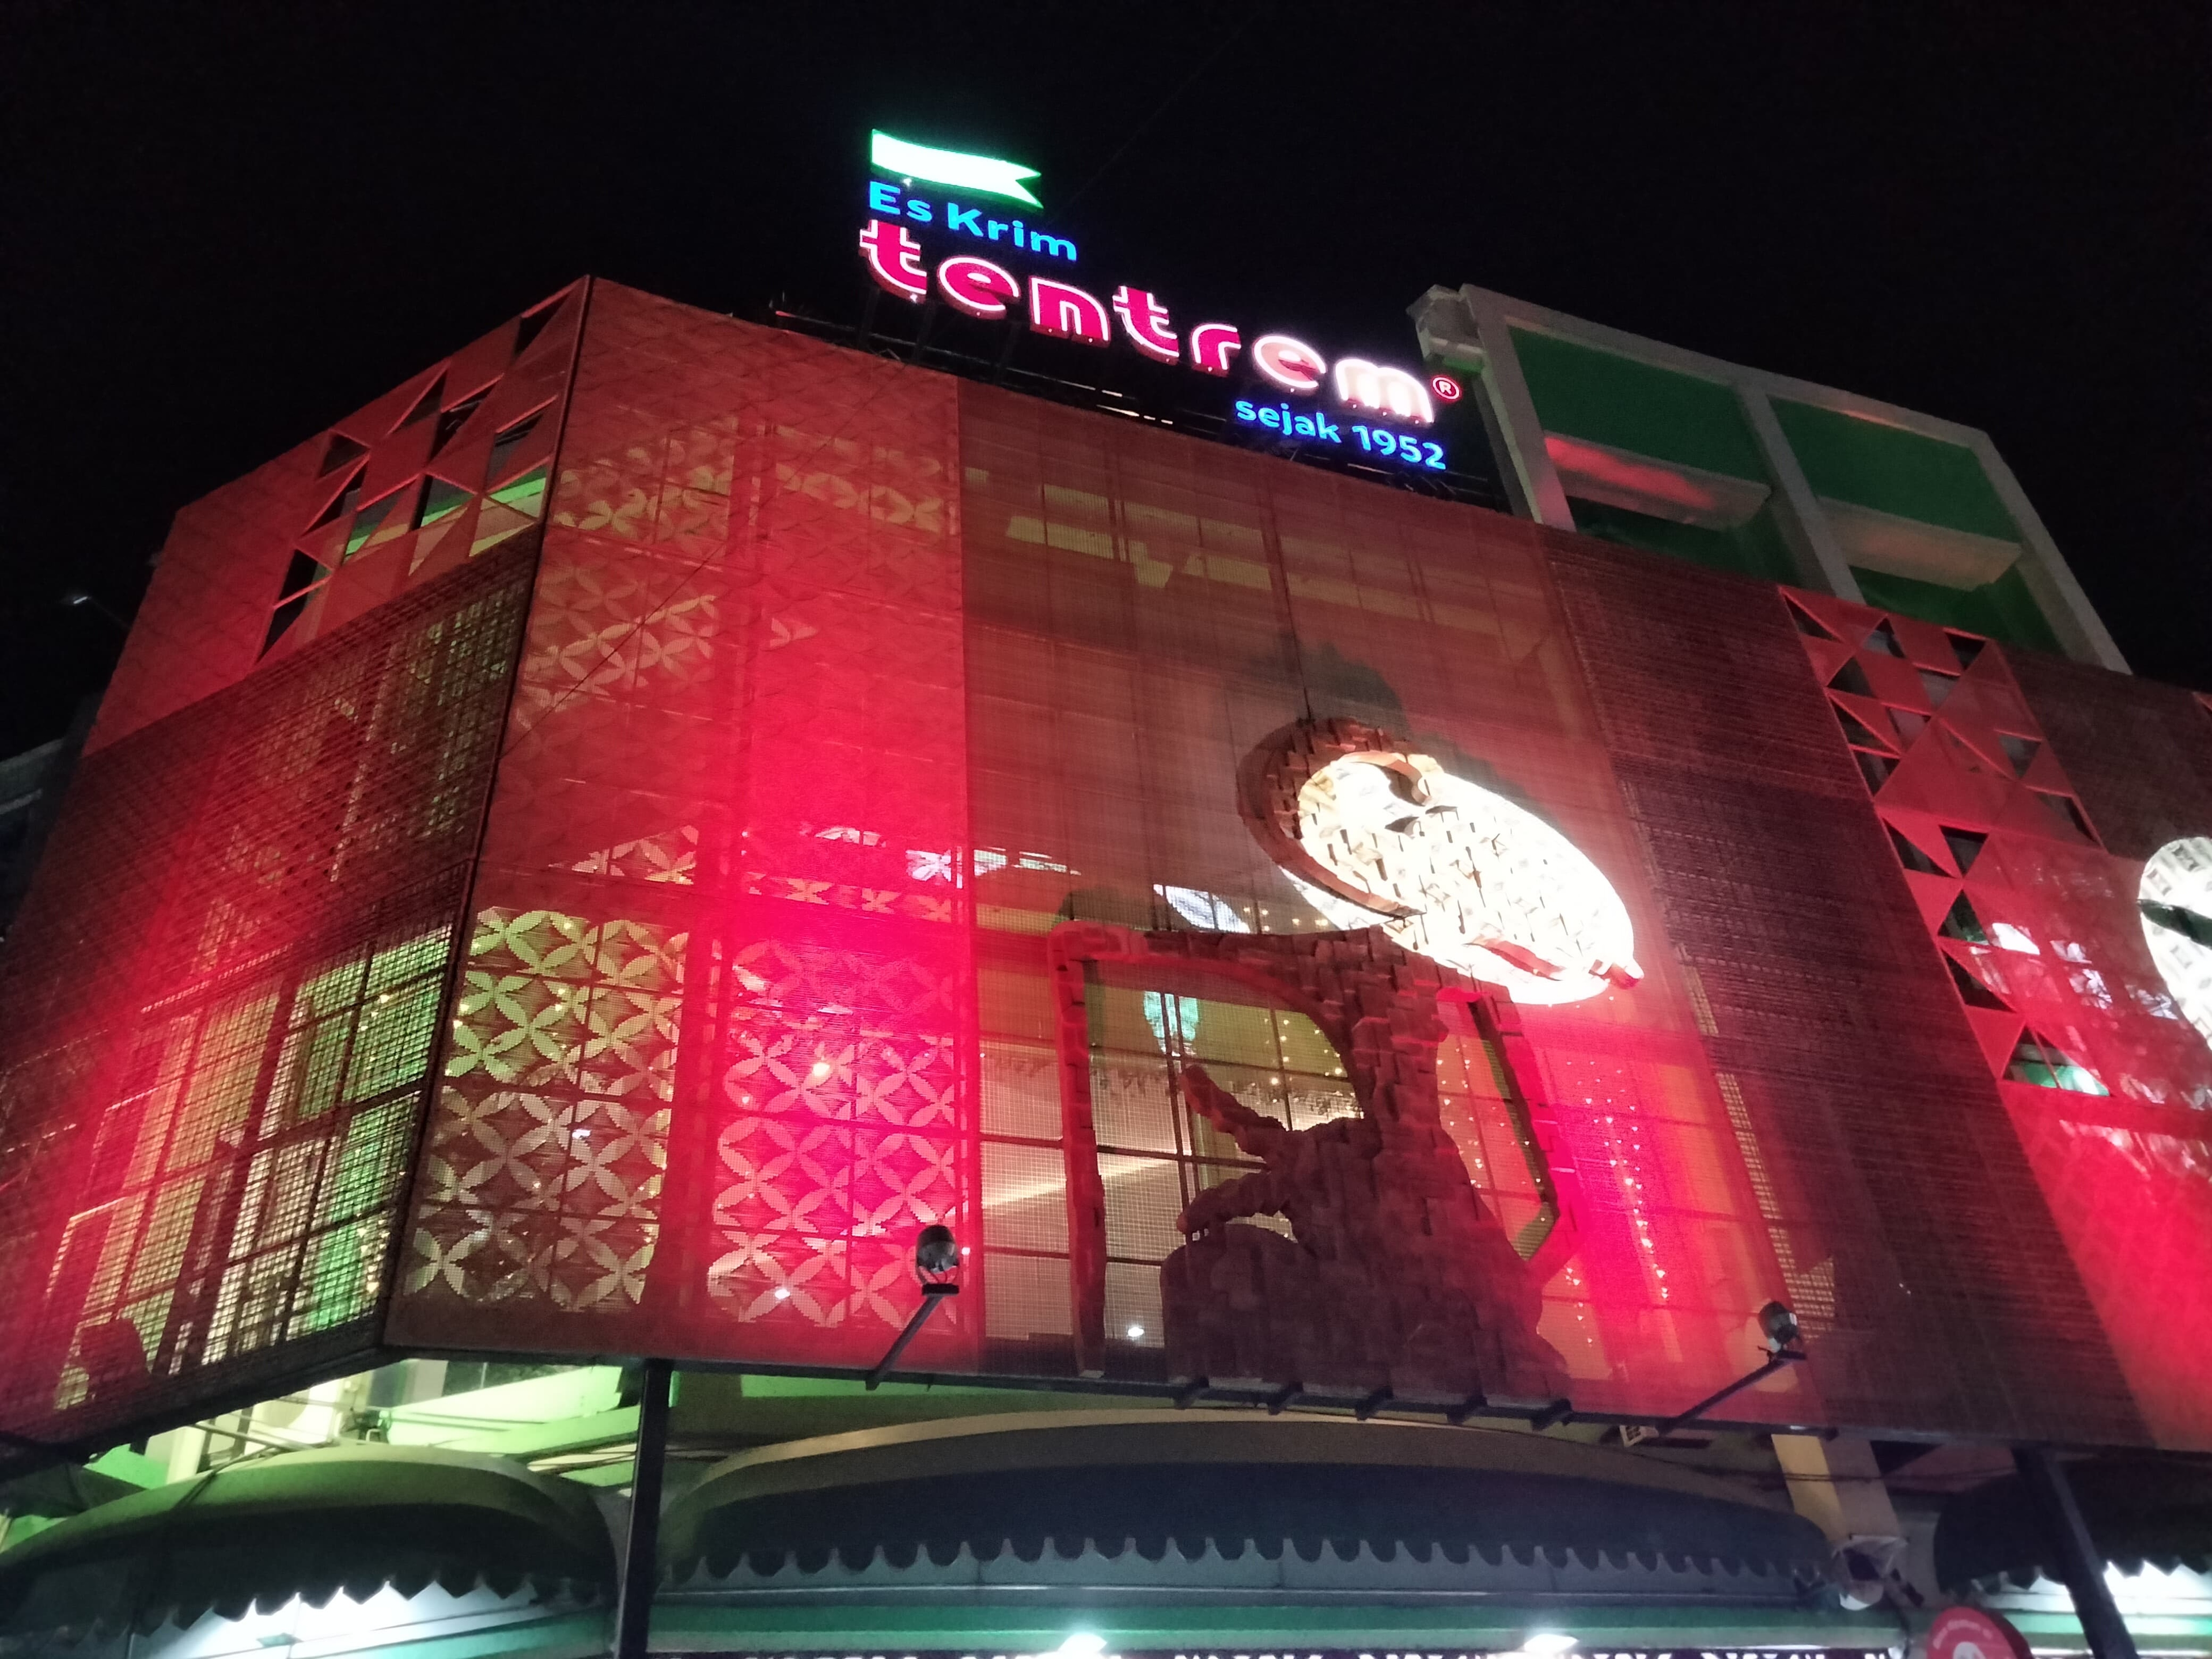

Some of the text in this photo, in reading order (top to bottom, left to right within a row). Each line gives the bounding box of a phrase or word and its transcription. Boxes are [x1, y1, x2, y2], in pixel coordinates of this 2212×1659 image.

[869, 181, 1078, 261] Es Krim
[860, 219, 1434, 424] tentrem
[1236, 399, 1447, 469] sejak 1952
